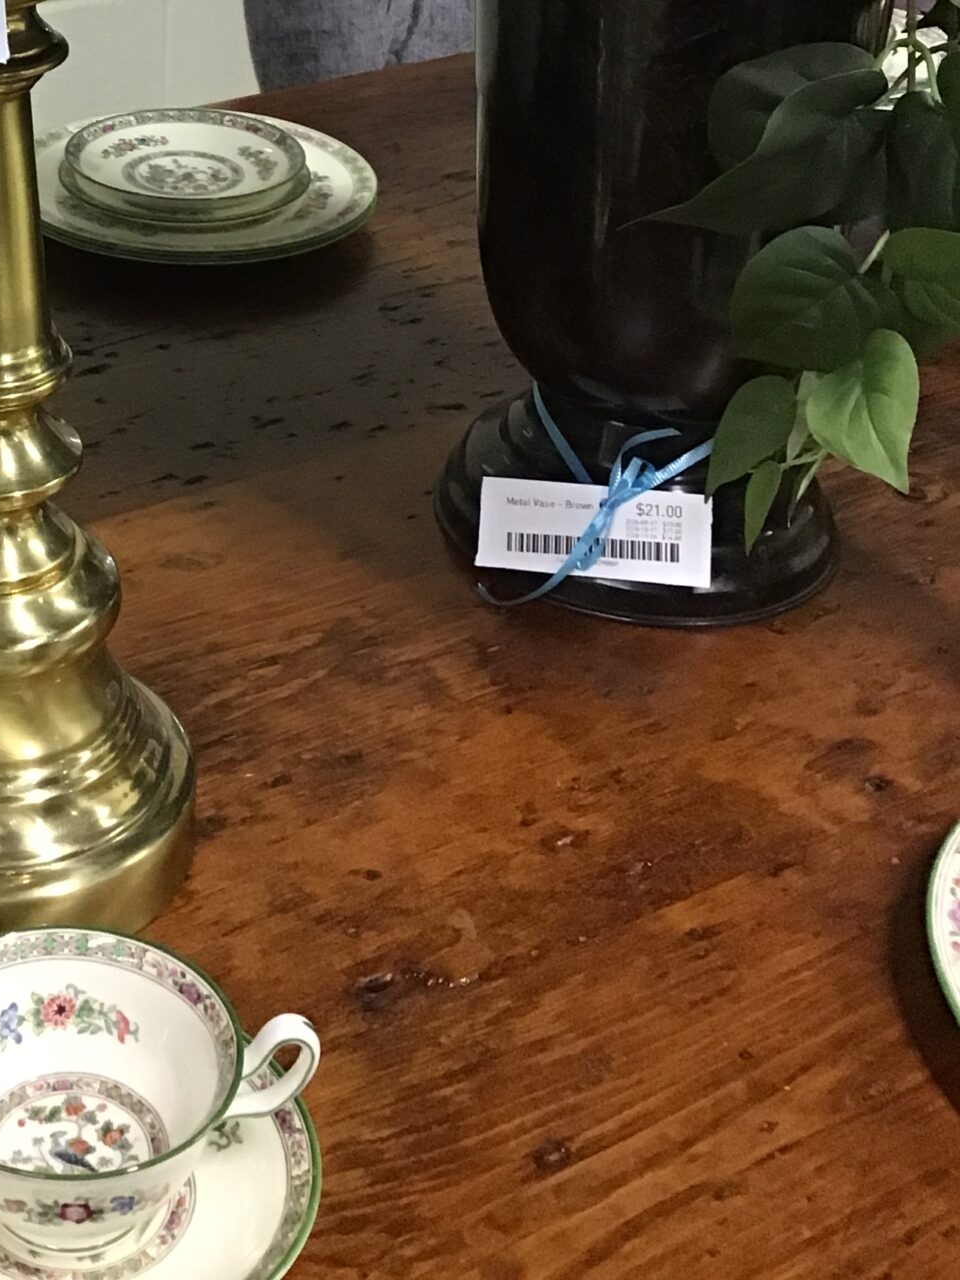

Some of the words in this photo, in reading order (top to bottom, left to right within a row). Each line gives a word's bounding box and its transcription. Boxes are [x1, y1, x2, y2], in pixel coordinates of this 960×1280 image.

[506, 496, 530, 507] Metal
[533, 498, 556, 508] Vase
[565, 499, 593, 510] Brown
[636, 502, 682, 518] $21.00
